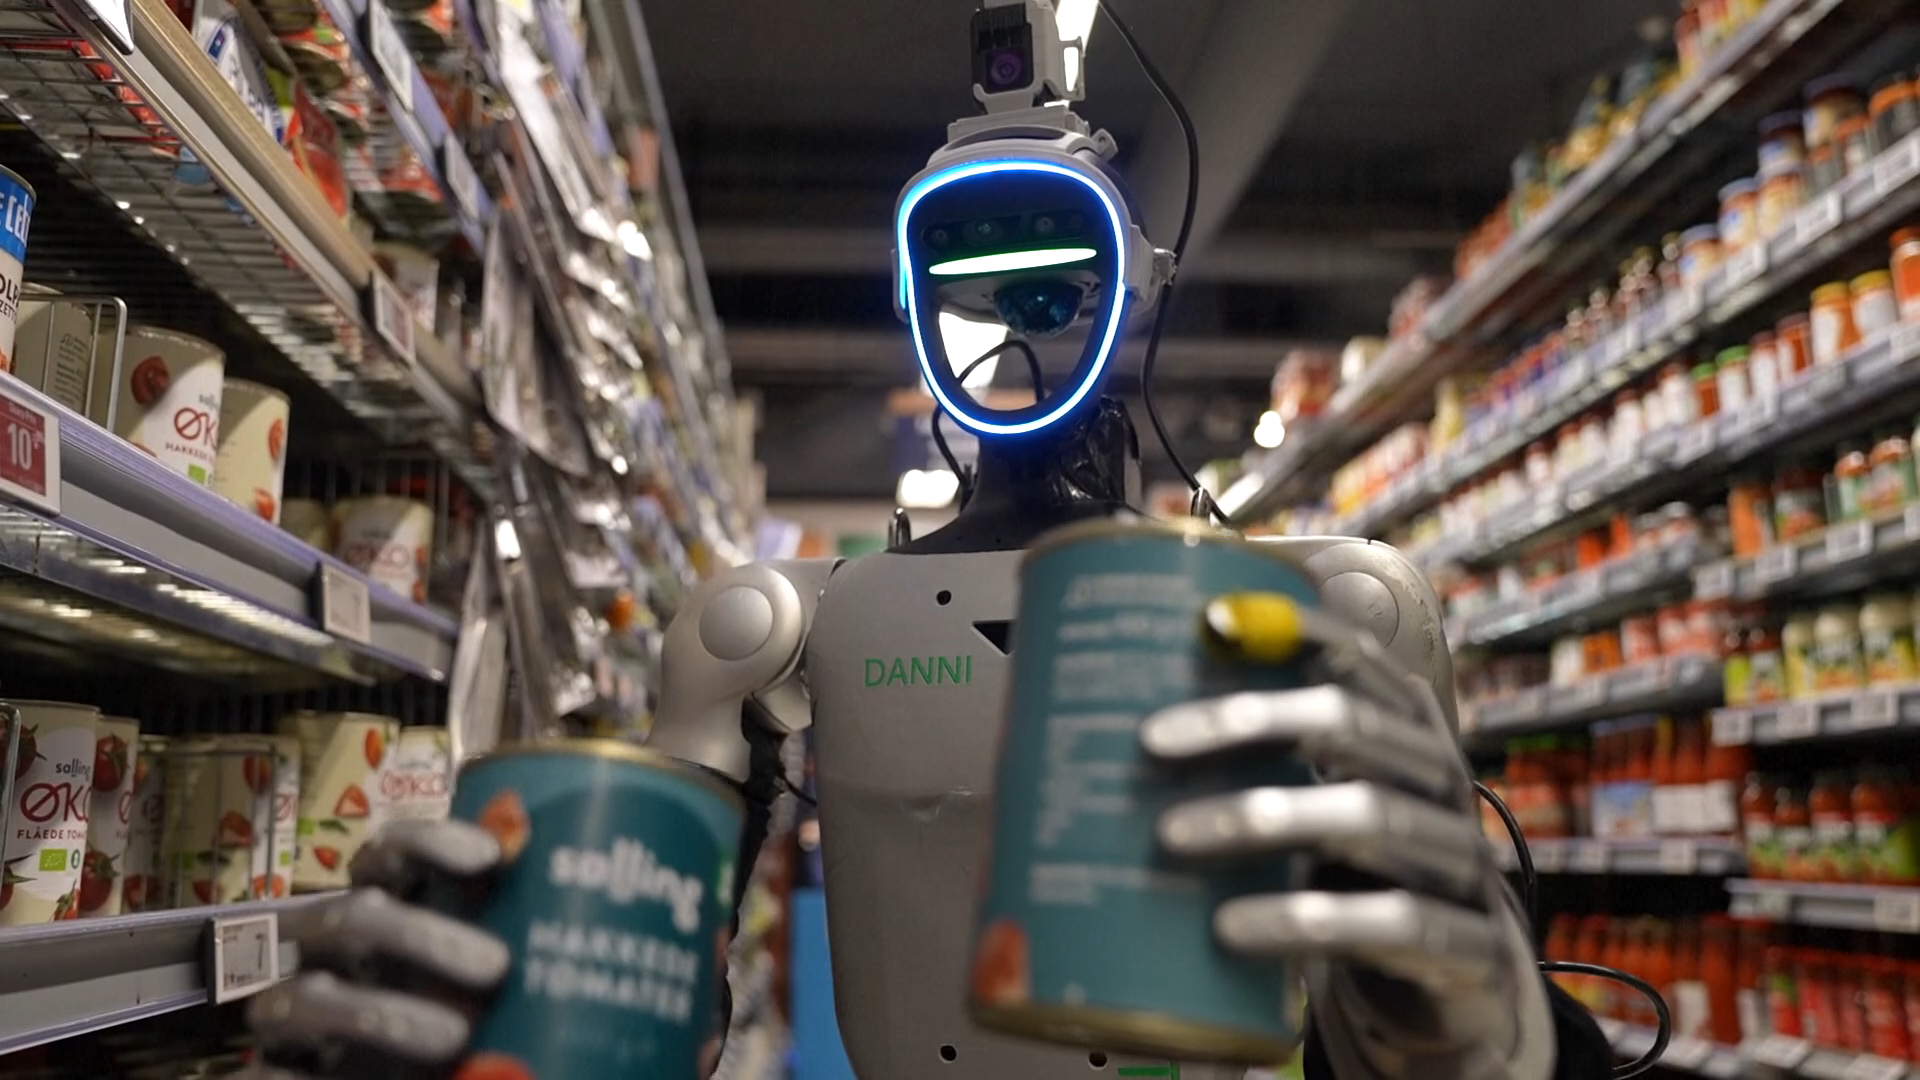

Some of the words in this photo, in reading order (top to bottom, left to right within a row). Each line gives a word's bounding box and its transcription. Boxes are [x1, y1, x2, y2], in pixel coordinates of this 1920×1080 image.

[8, 422, 32, 471] 10
[864, 655, 972, 687] DANNI
[56, 758, 91, 781] salling
[16, 826, 64, 840] FLÅEDE
[549, 837, 705, 933] salling
